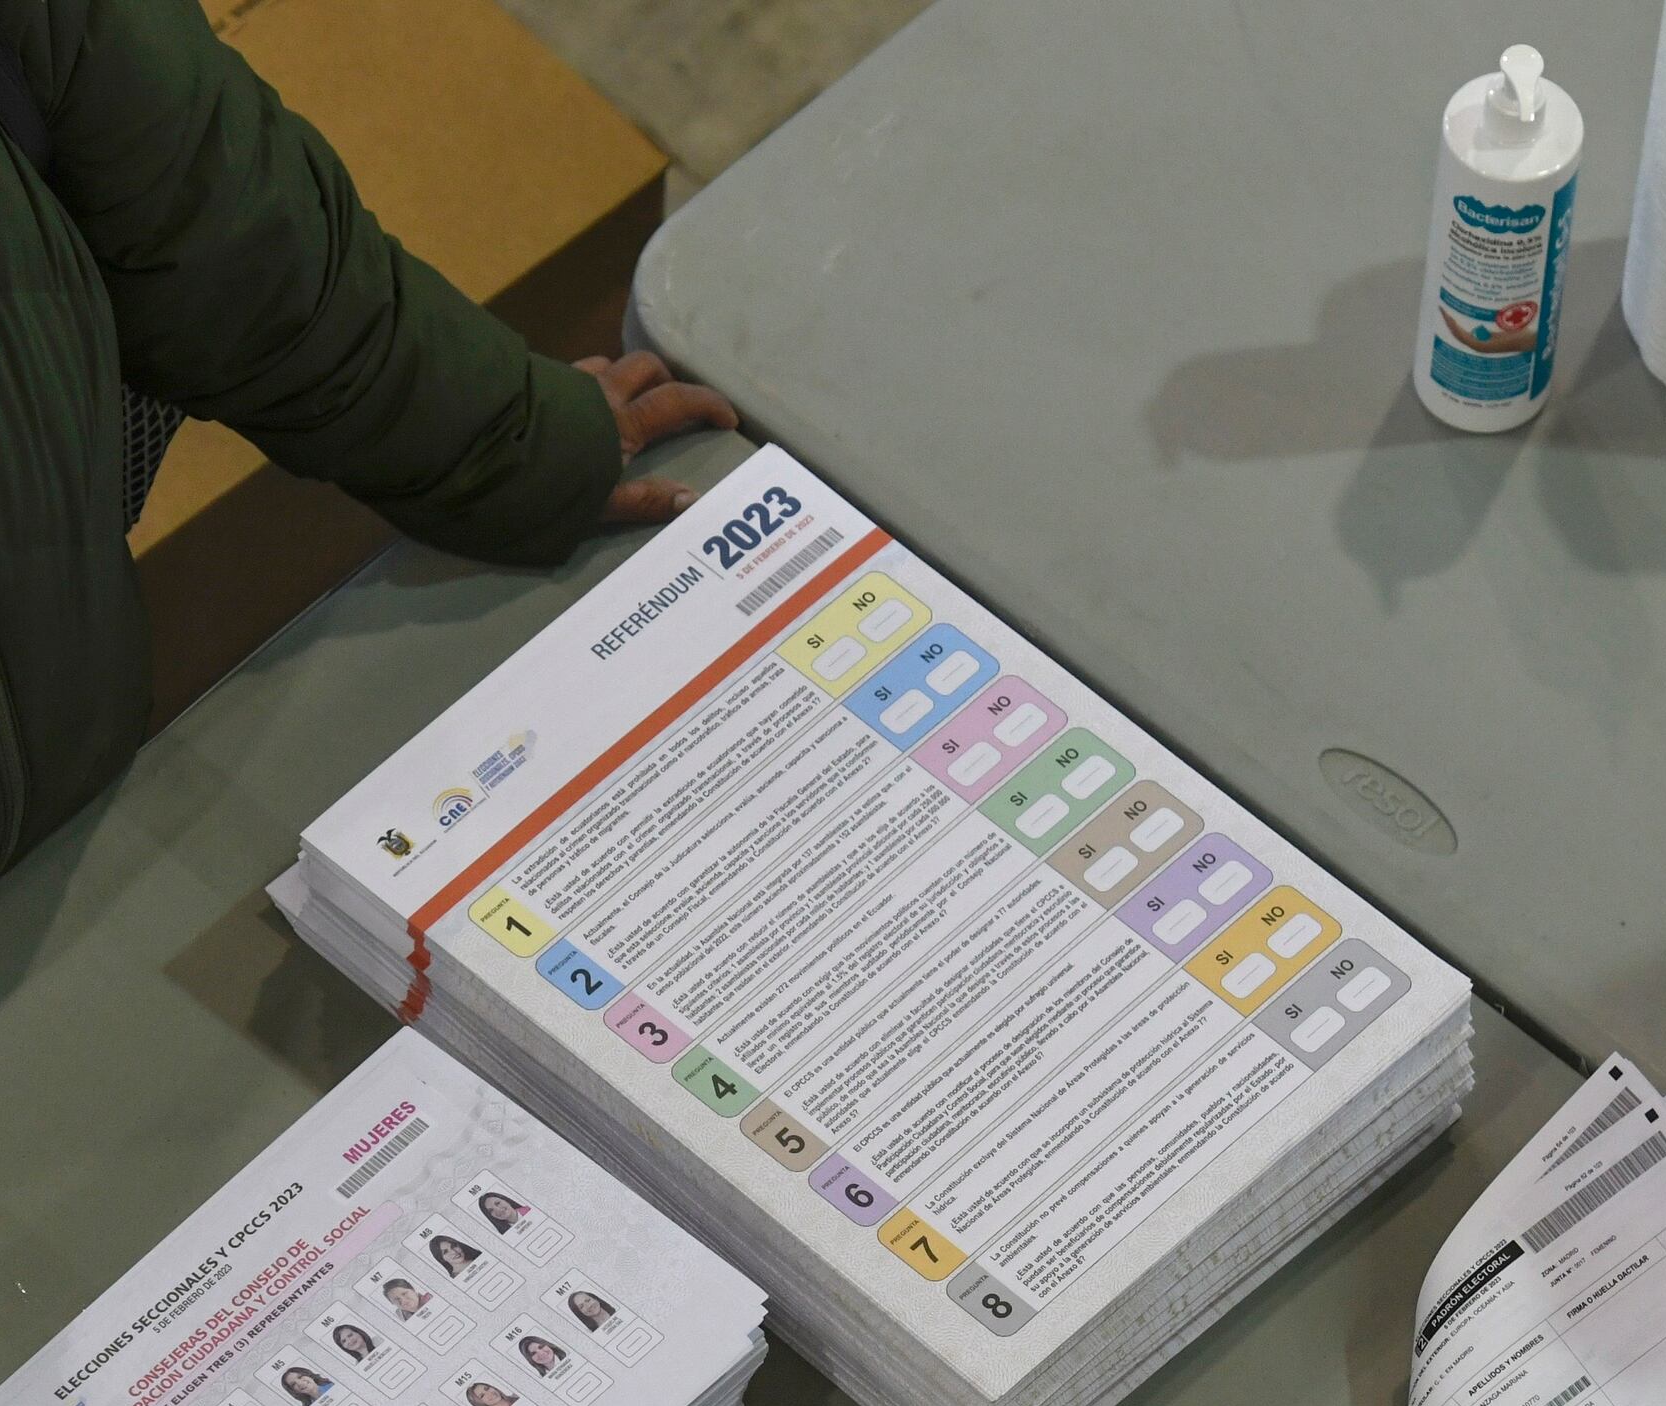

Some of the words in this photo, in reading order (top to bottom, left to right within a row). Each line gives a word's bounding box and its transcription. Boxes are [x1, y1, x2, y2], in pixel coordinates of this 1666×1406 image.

[1457, 200, 1540, 230] Bacterisan
[590, 565, 704, 660] REFERÉNDUM
[703, 486, 802, 569] 2023
[742, 563, 755, 574] DE
[752, 537, 786, 565] FEBRERO
[784, 529, 797, 539] DE
[794, 514, 814, 530] 2023
[806, 633, 824, 648] SI
[852, 591, 876, 611] NO
[874, 685, 892, 701] SI
[919, 643, 943, 663] NO
[941, 738, 960, 753] SI
[987, 695, 1011, 715] NO
[1010, 791, 1028, 806] SI
[1055, 747, 1079, 768] NO
[1078, 843, 1096, 859] SI
[1123, 800, 1147, 820] NO
[479, 897, 510, 922] PREGUNTA
[1146, 896, 1165, 911] SI
[1192, 852, 1216, 872] NO
[506, 915, 532, 936] 1
[1215, 949, 1233, 965] SI
[1260, 906, 1284, 926] NO
[570, 968, 603, 995] 2
[1284, 1003, 1303, 1019] SI
[1330, 959, 1354, 979] NO
[638, 1021, 668, 1046] 3
[711, 1073, 738, 1099] 4
[342, 1101, 416, 1164] MUJERES
[775, 1126, 805, 1154] 5
[468, 1184, 482, 1196] M9
[845, 1183, 874, 1207] 6
[910, 1235, 938, 1263] 7
[53, 1331, 133, 1400] ELECCIONES
[131, 1256, 218, 1333] SECCIONALES
[214, 1246, 228, 1257] Y
[228, 1210, 271, 1248] CPCCS
[268, 1182, 303, 1212] 2023
[181, 1305, 258, 1370] CIUDADANA
[253, 1293, 266, 1305] Y
[266, 1245, 326, 1296] CONTROL
[323, 1206, 371, 1246] SOCIAL
[555, 1280, 571, 1296] M17
[958, 1274, 989, 1300] PREGUNTA
[982, 1292, 1013, 1318] 8
[1431, 1291, 1463, 1327] PADRÓN
[1461, 1253, 1510, 1294] ELECTORAL
[1566, 1301, 1588, 1319] FIRMA
[1592, 1278, 1618, 1299] HUELLA
[1616, 1254, 1649, 1281] DACTILAR
[128, 1327, 207, 1396] CONSEJERAS
[204, 1307, 234, 1330] DEL
[231, 1256, 289, 1306] CONSEJO
[286, 1238, 309, 1257] DE
[170, 1372, 208, 1405] ELIGEN
[205, 1350, 234, 1372] TRES
[233, 1337, 249, 1351] (3)
[246, 1261, 334, 1338] REPRESENTANTES
[1468, 1363, 1506, 1396] APELLIDOS
[1510, 1334, 1544, 1361] NOMBRES
